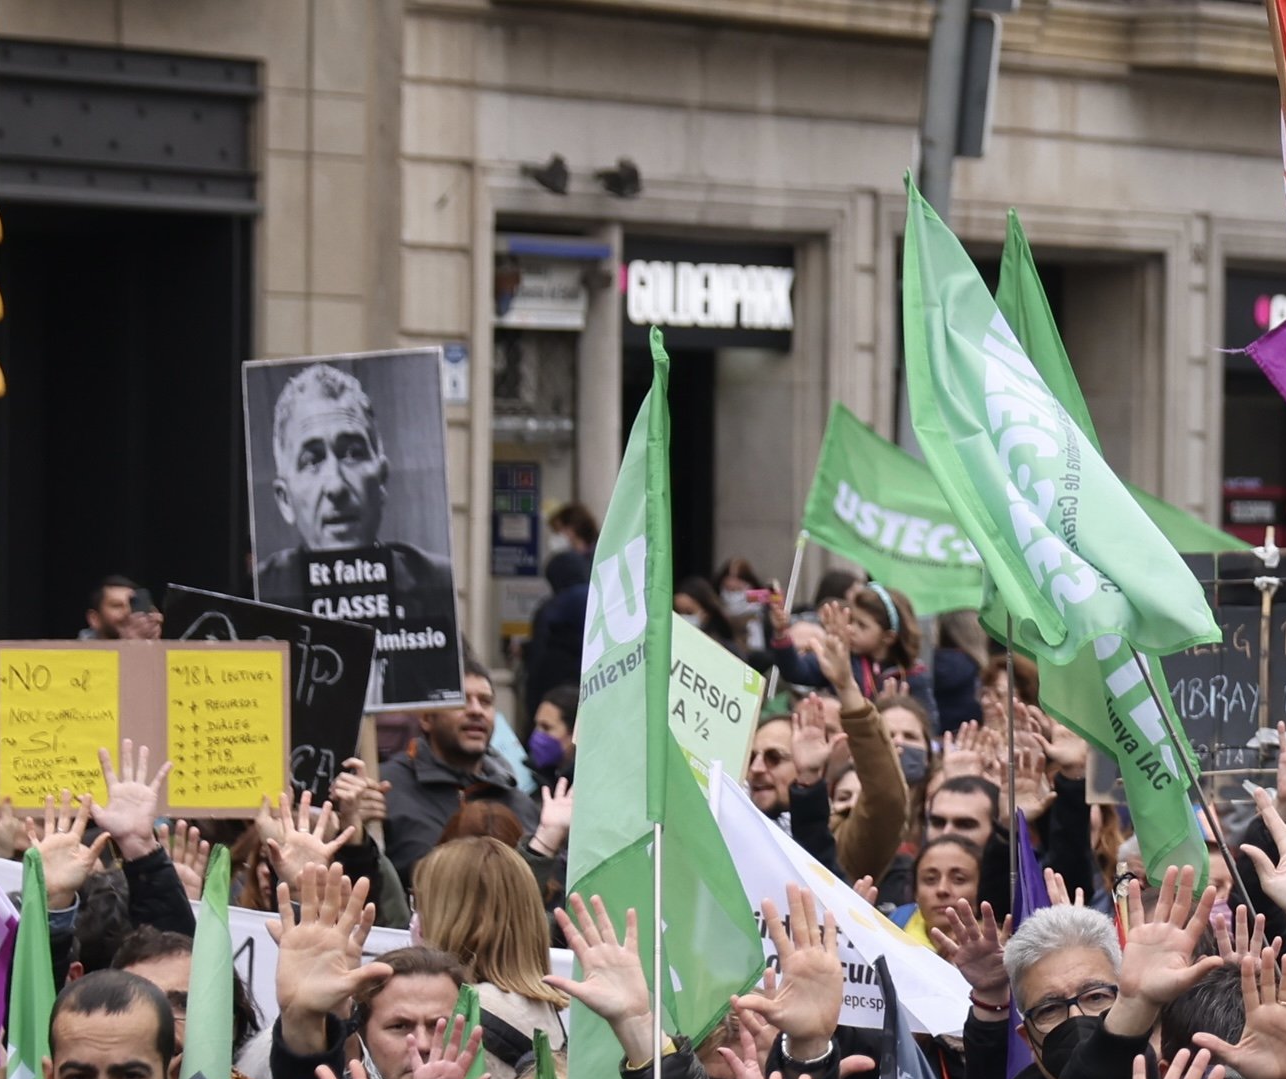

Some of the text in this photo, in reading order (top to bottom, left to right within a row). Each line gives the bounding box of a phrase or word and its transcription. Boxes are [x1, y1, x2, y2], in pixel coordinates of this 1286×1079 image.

[308, 558, 388, 586] Et falta
[312, 593, 390, 621] CLASSE
[7, 661, 52, 692] NO
[671, 698, 687, 723] A
[1135, 751, 1173, 792] IAC
